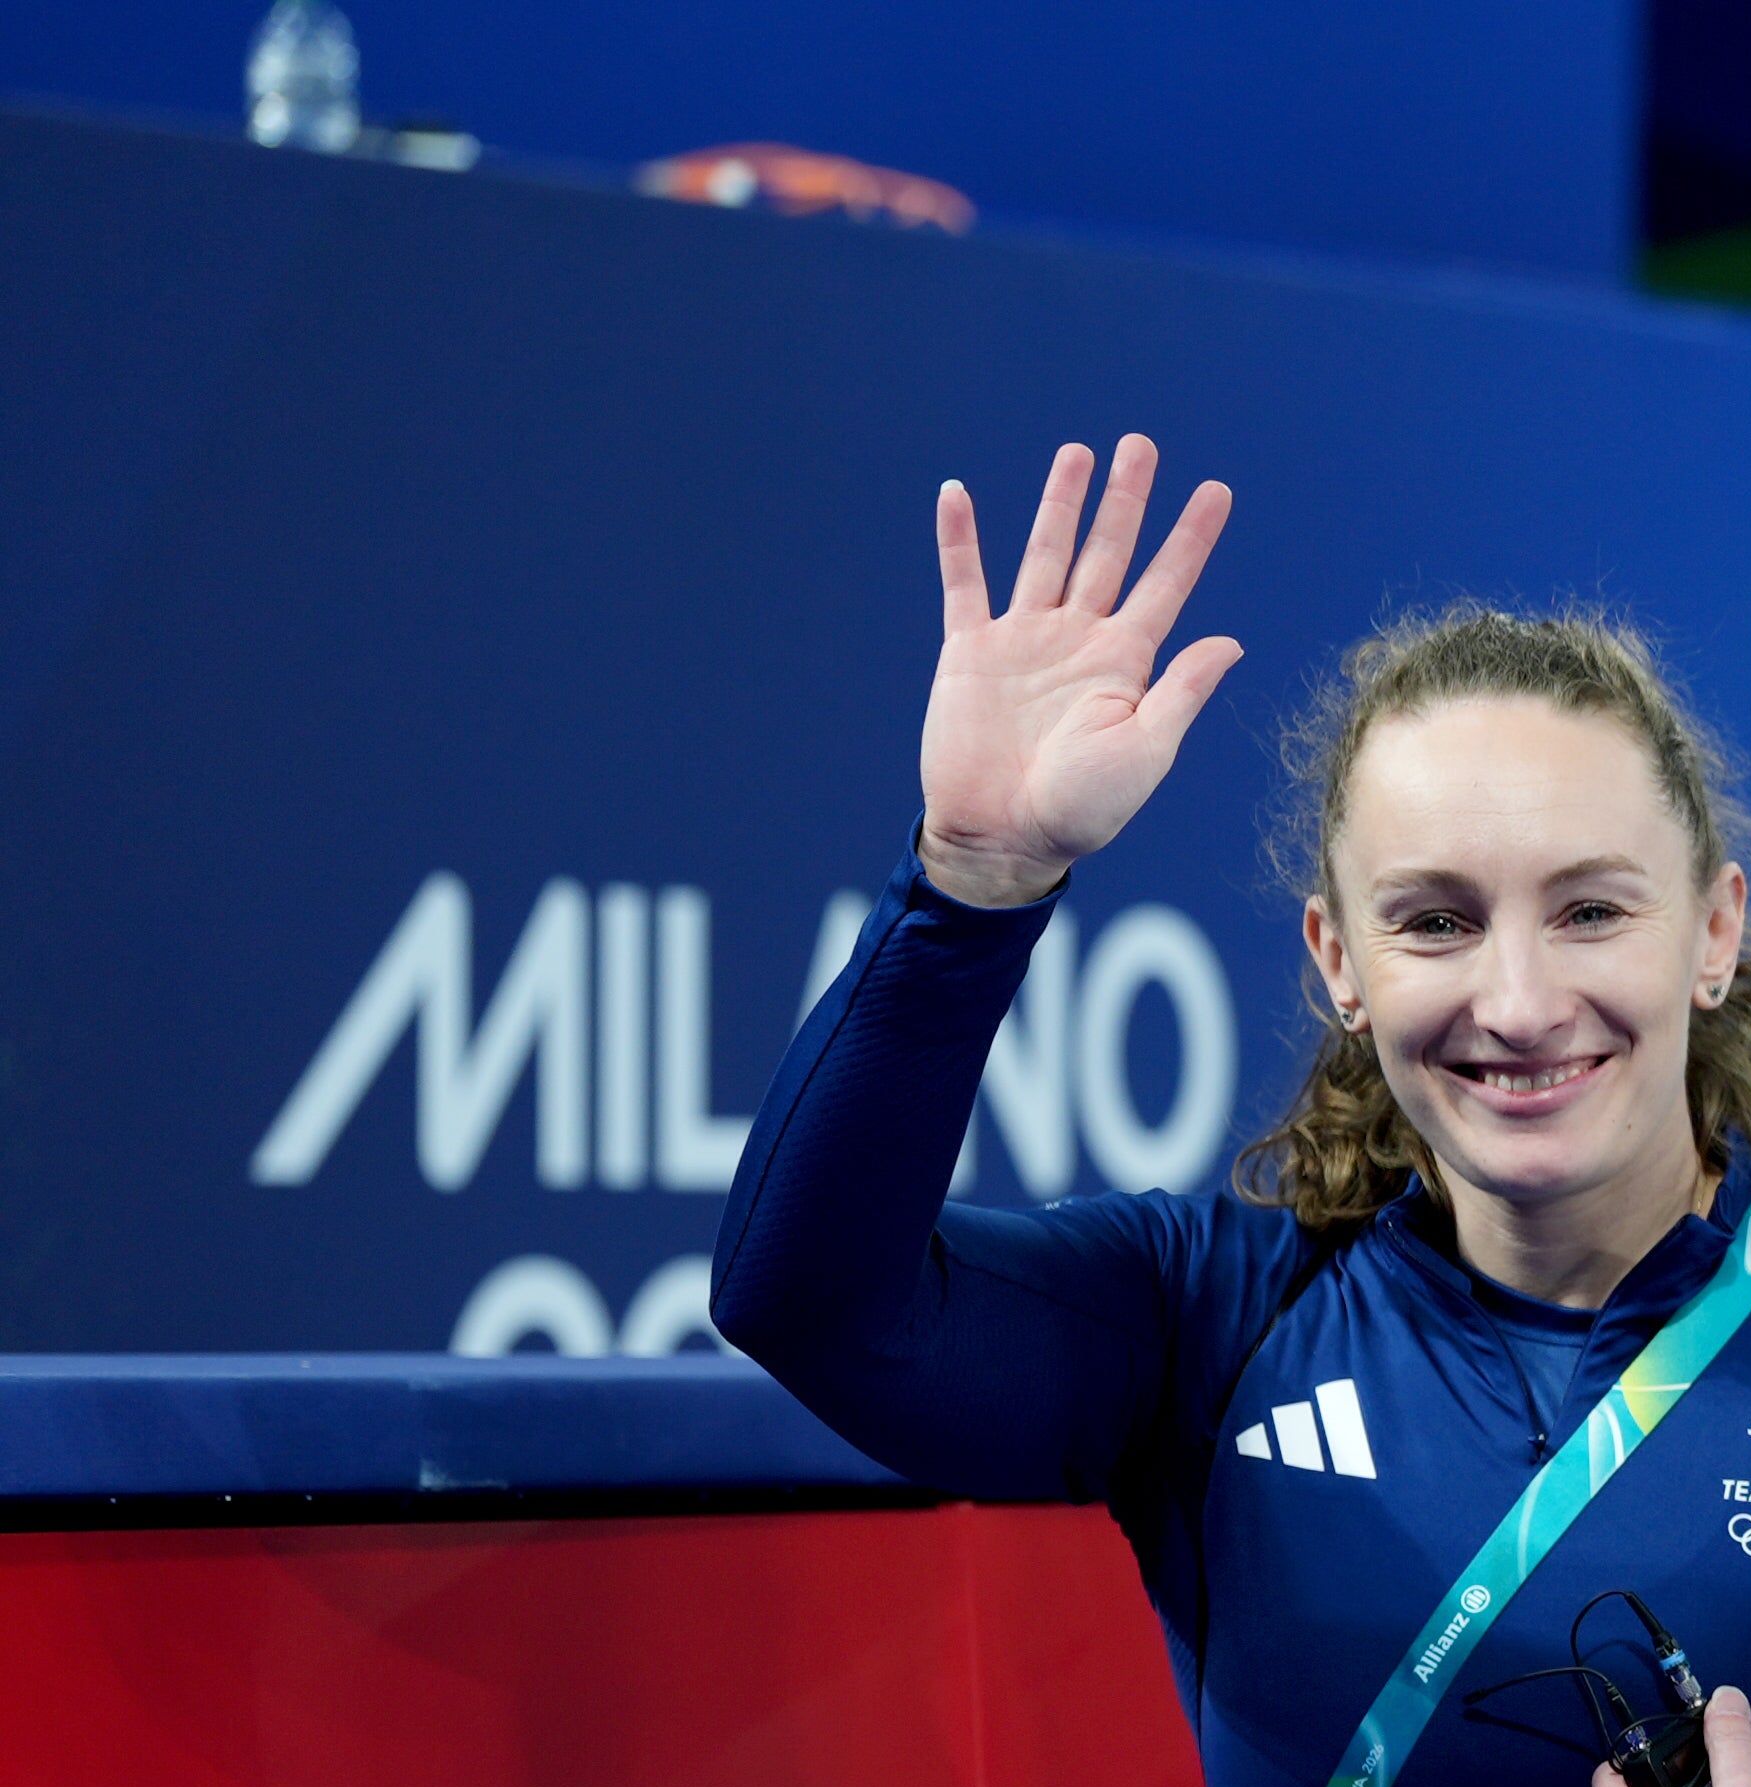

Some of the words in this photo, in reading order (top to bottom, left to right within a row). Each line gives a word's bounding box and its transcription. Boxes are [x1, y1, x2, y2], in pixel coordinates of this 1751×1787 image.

[250, 870, 1239, 1201] MILNO
[1413, 1612, 1471, 1684] Allianz
[1362, 1743, 1385, 1775] 2026
